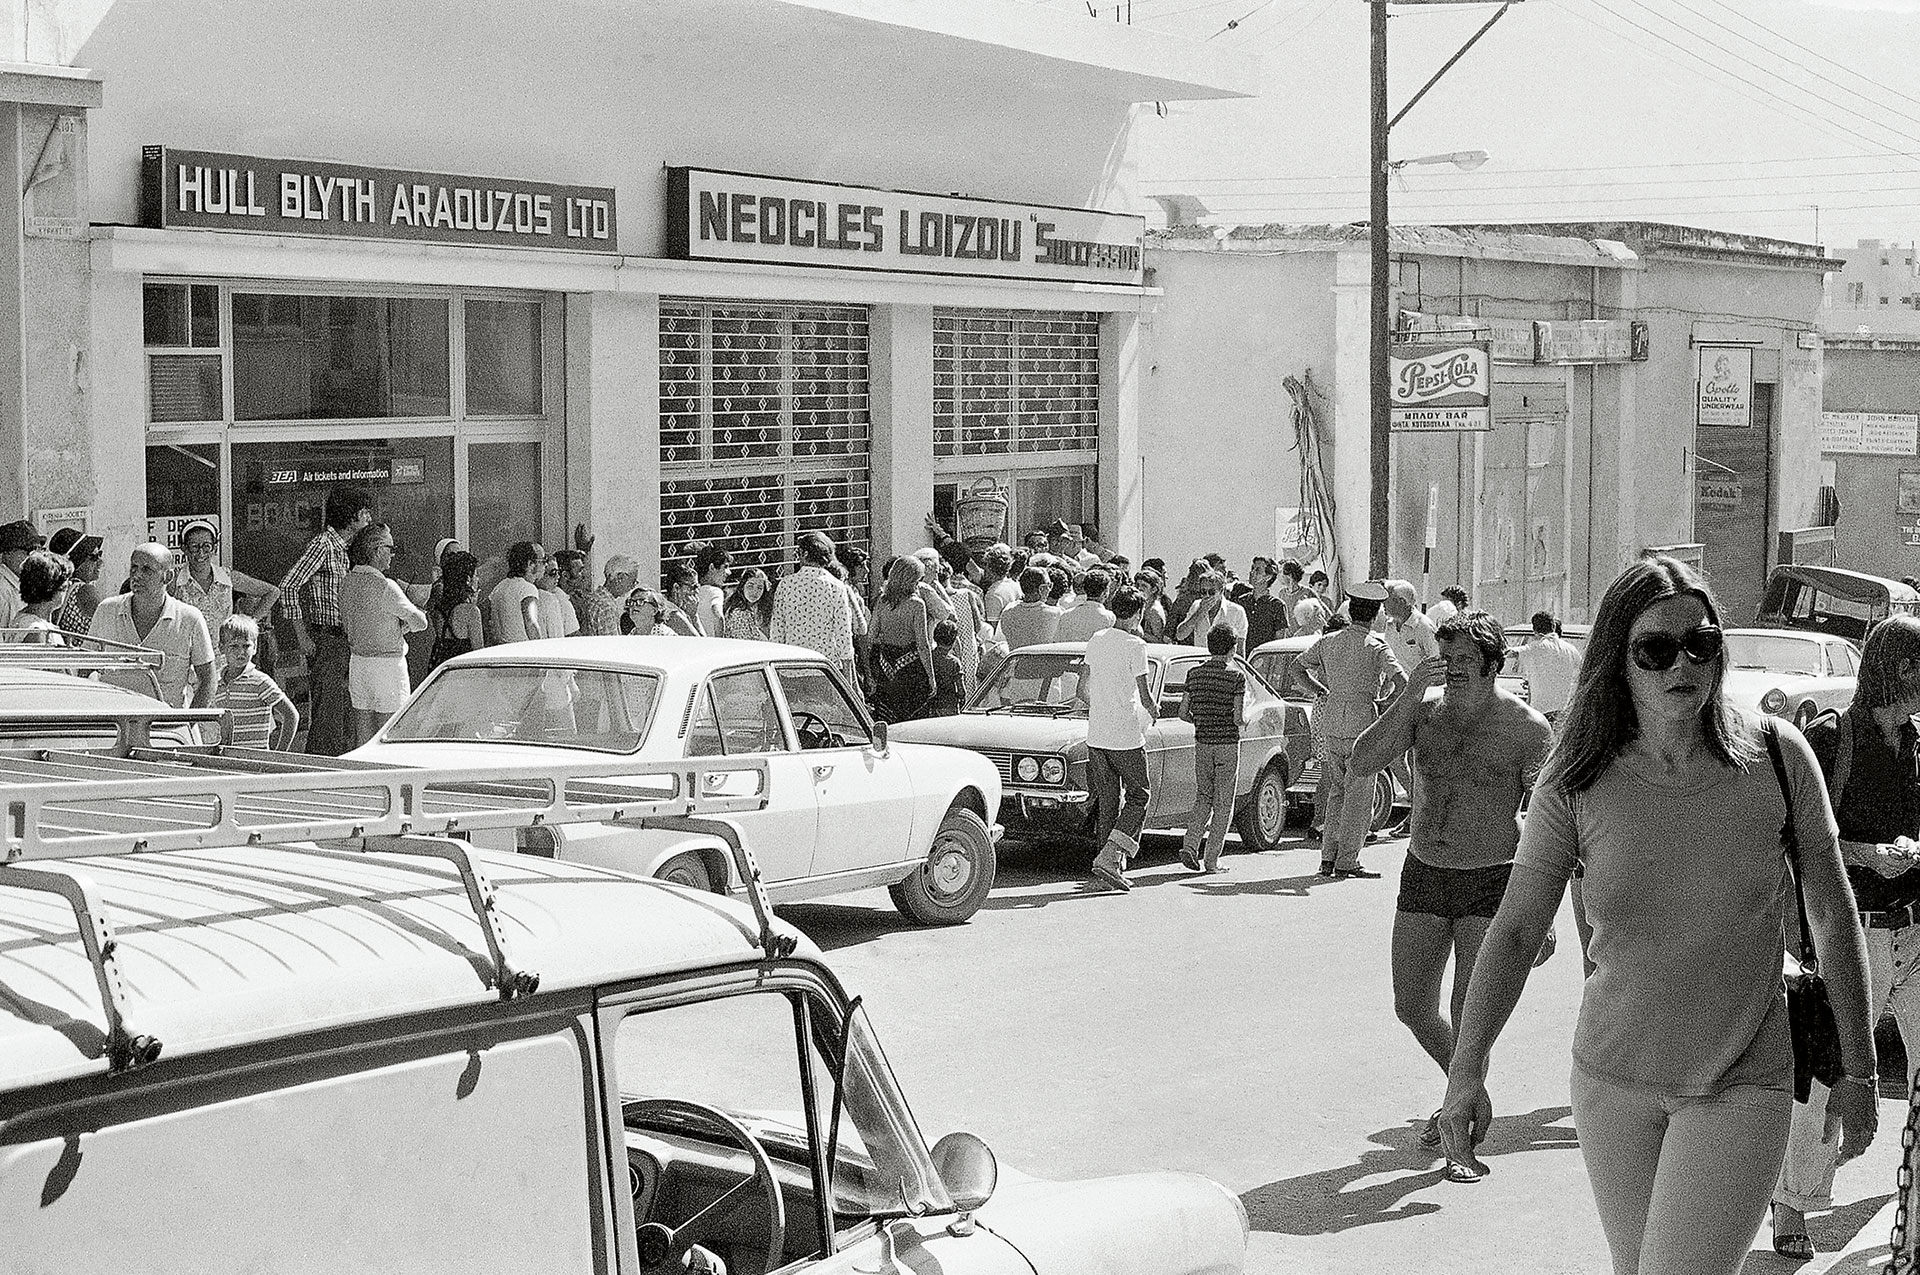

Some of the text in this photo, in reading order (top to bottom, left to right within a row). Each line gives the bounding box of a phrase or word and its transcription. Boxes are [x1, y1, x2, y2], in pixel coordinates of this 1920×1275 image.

[179, 164, 609, 239] HULL BLYTH ARAOUZOS LTD
[700, 190, 883, 252] NEOCLES
[900, 209, 1022, 262] LOIZOU
[303, 472, 314, 482] Air
[315, 471, 338, 482] tickets
[338, 470, 351, 480] and
[352, 469, 389, 480] information
[1701, 486, 1737, 498] Kodak
